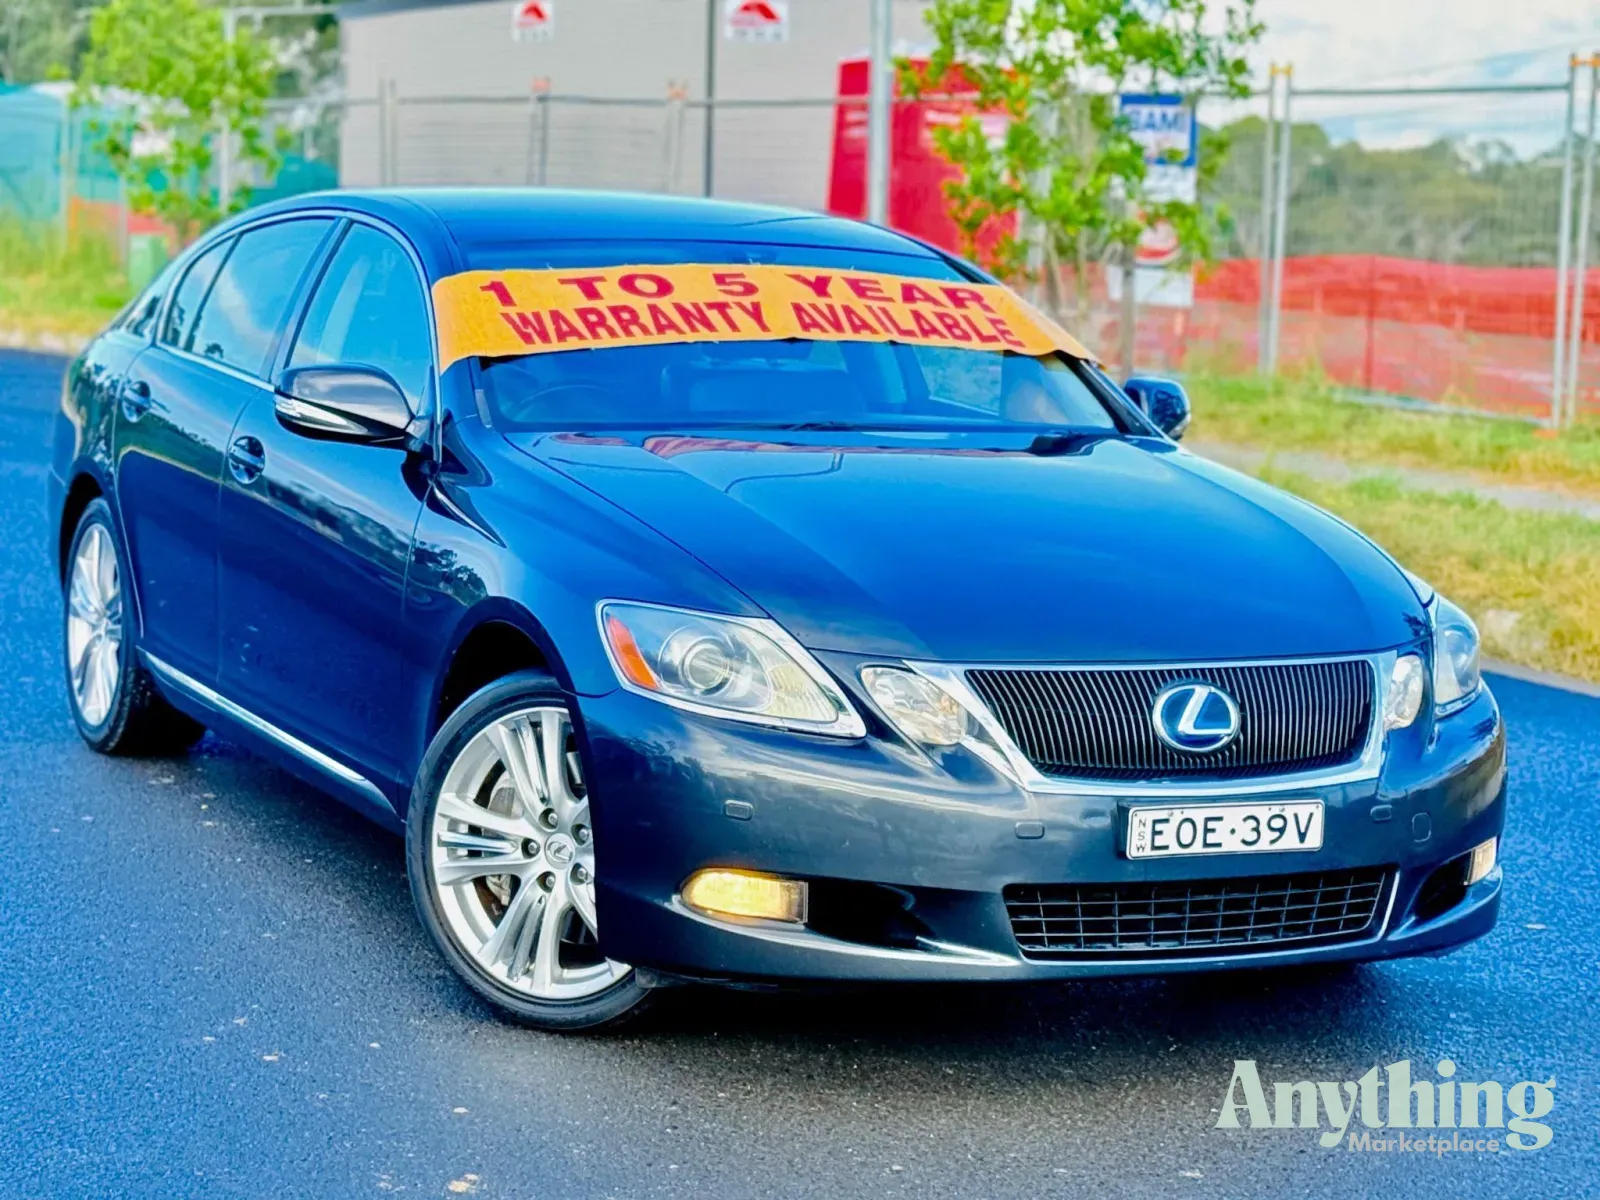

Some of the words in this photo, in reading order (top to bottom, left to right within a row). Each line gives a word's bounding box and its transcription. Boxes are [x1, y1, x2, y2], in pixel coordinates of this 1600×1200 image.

[480, 280, 517, 307] 1
[557, 273, 675, 301] TO
[712, 273, 759, 297] 5
[784, 273, 996, 314] YEAR
[499, 301, 772, 346] WARRANTY
[791, 302, 1026, 348] AVAILABLE
